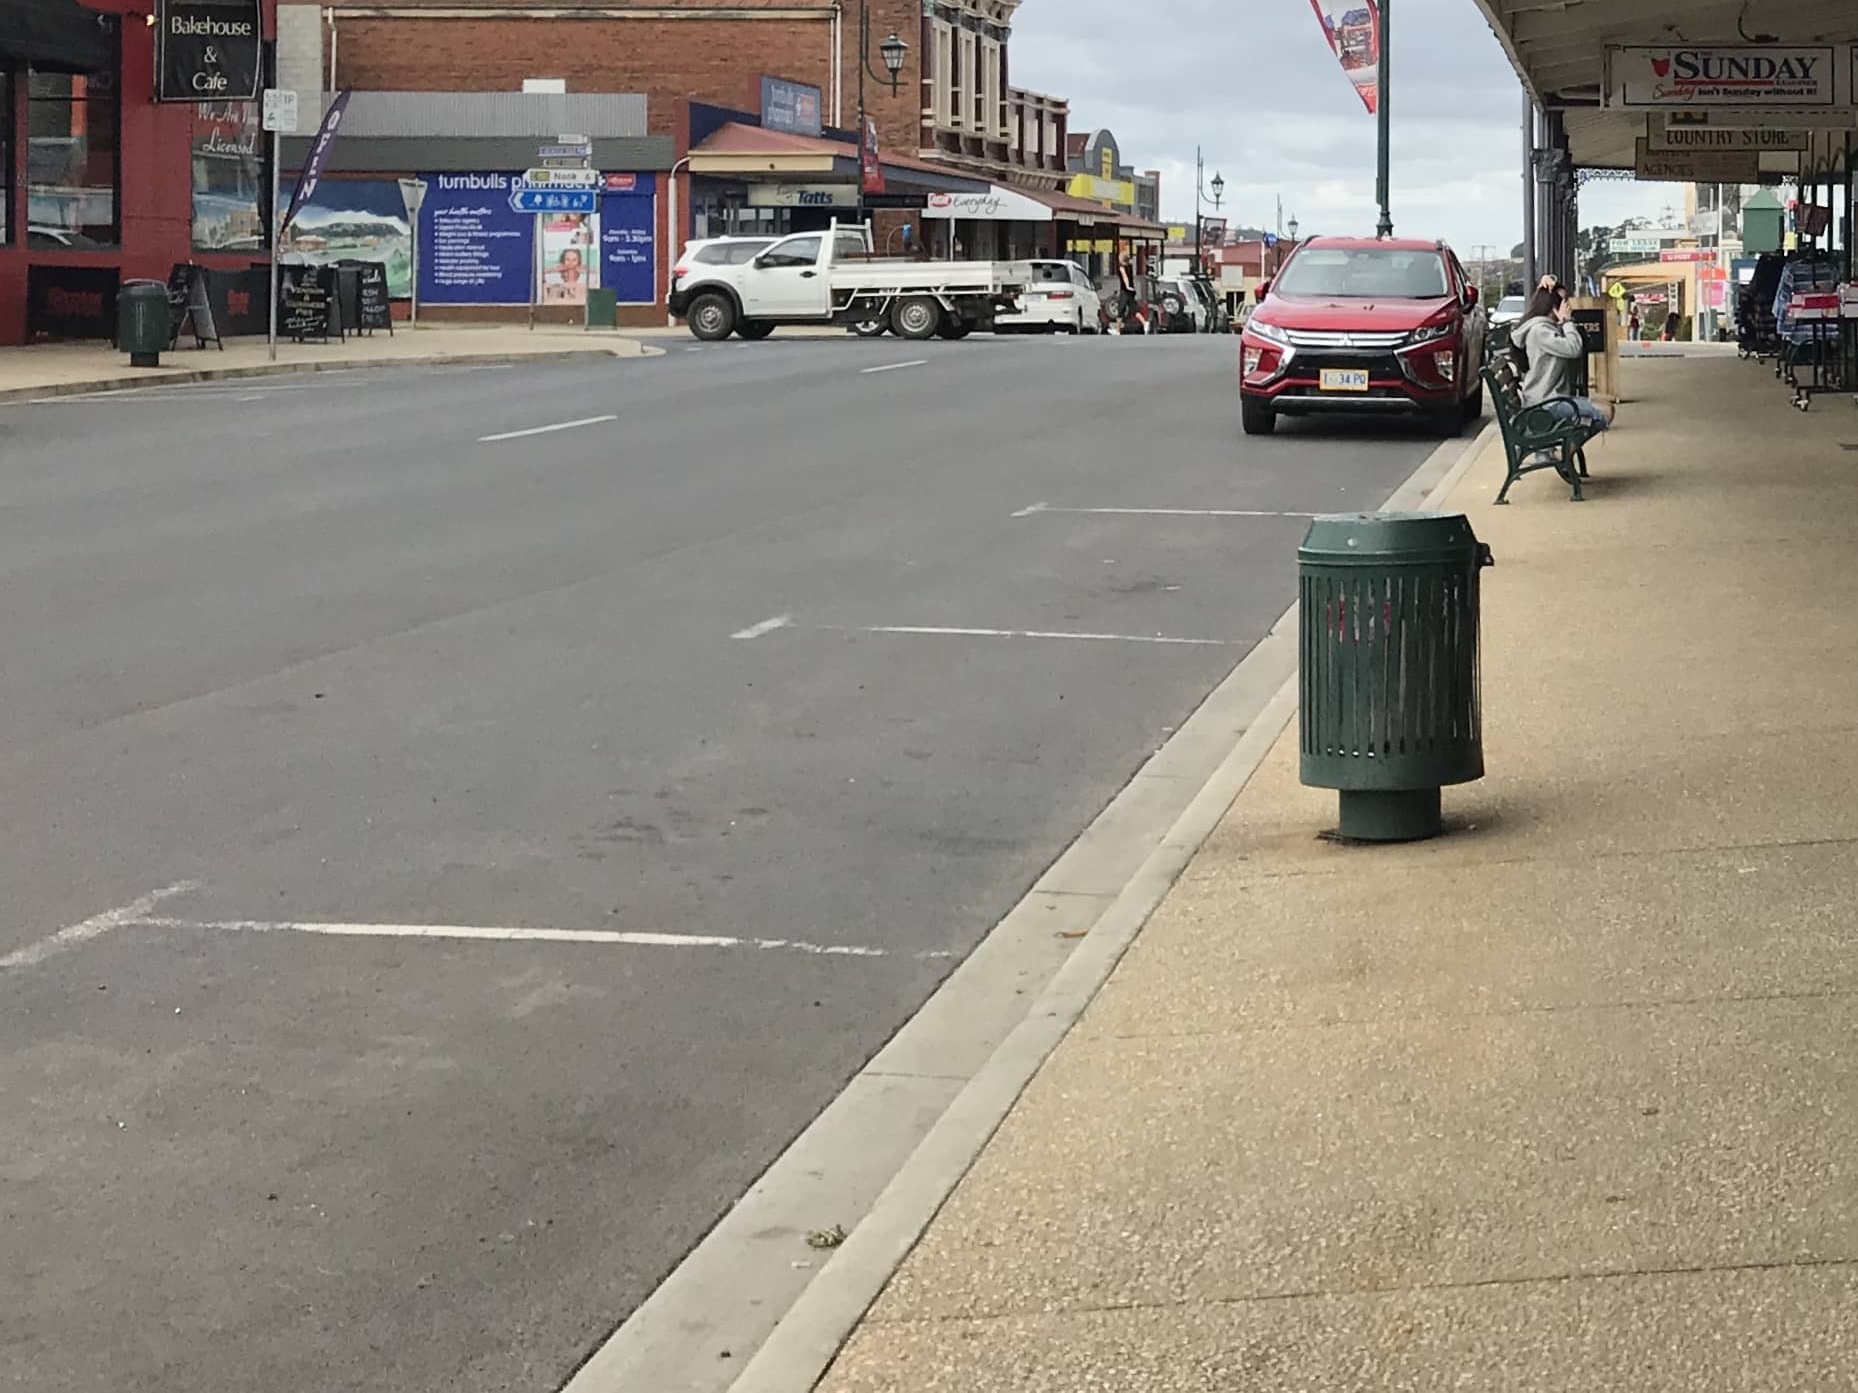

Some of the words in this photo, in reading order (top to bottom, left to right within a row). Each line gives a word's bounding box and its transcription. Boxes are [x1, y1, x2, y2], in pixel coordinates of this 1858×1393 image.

[171, 15, 251, 36] Bakehouse
[203, 45, 217, 63] &
[1673, 51, 1818, 80] SUNDAY
[192, 71, 228, 91] Cafe
[438, 173, 507, 189] turnbulls
[553, 172, 577, 180] Nook
[797, 189, 833, 205] Tatts
[953, 194, 1003, 215] Everyday
